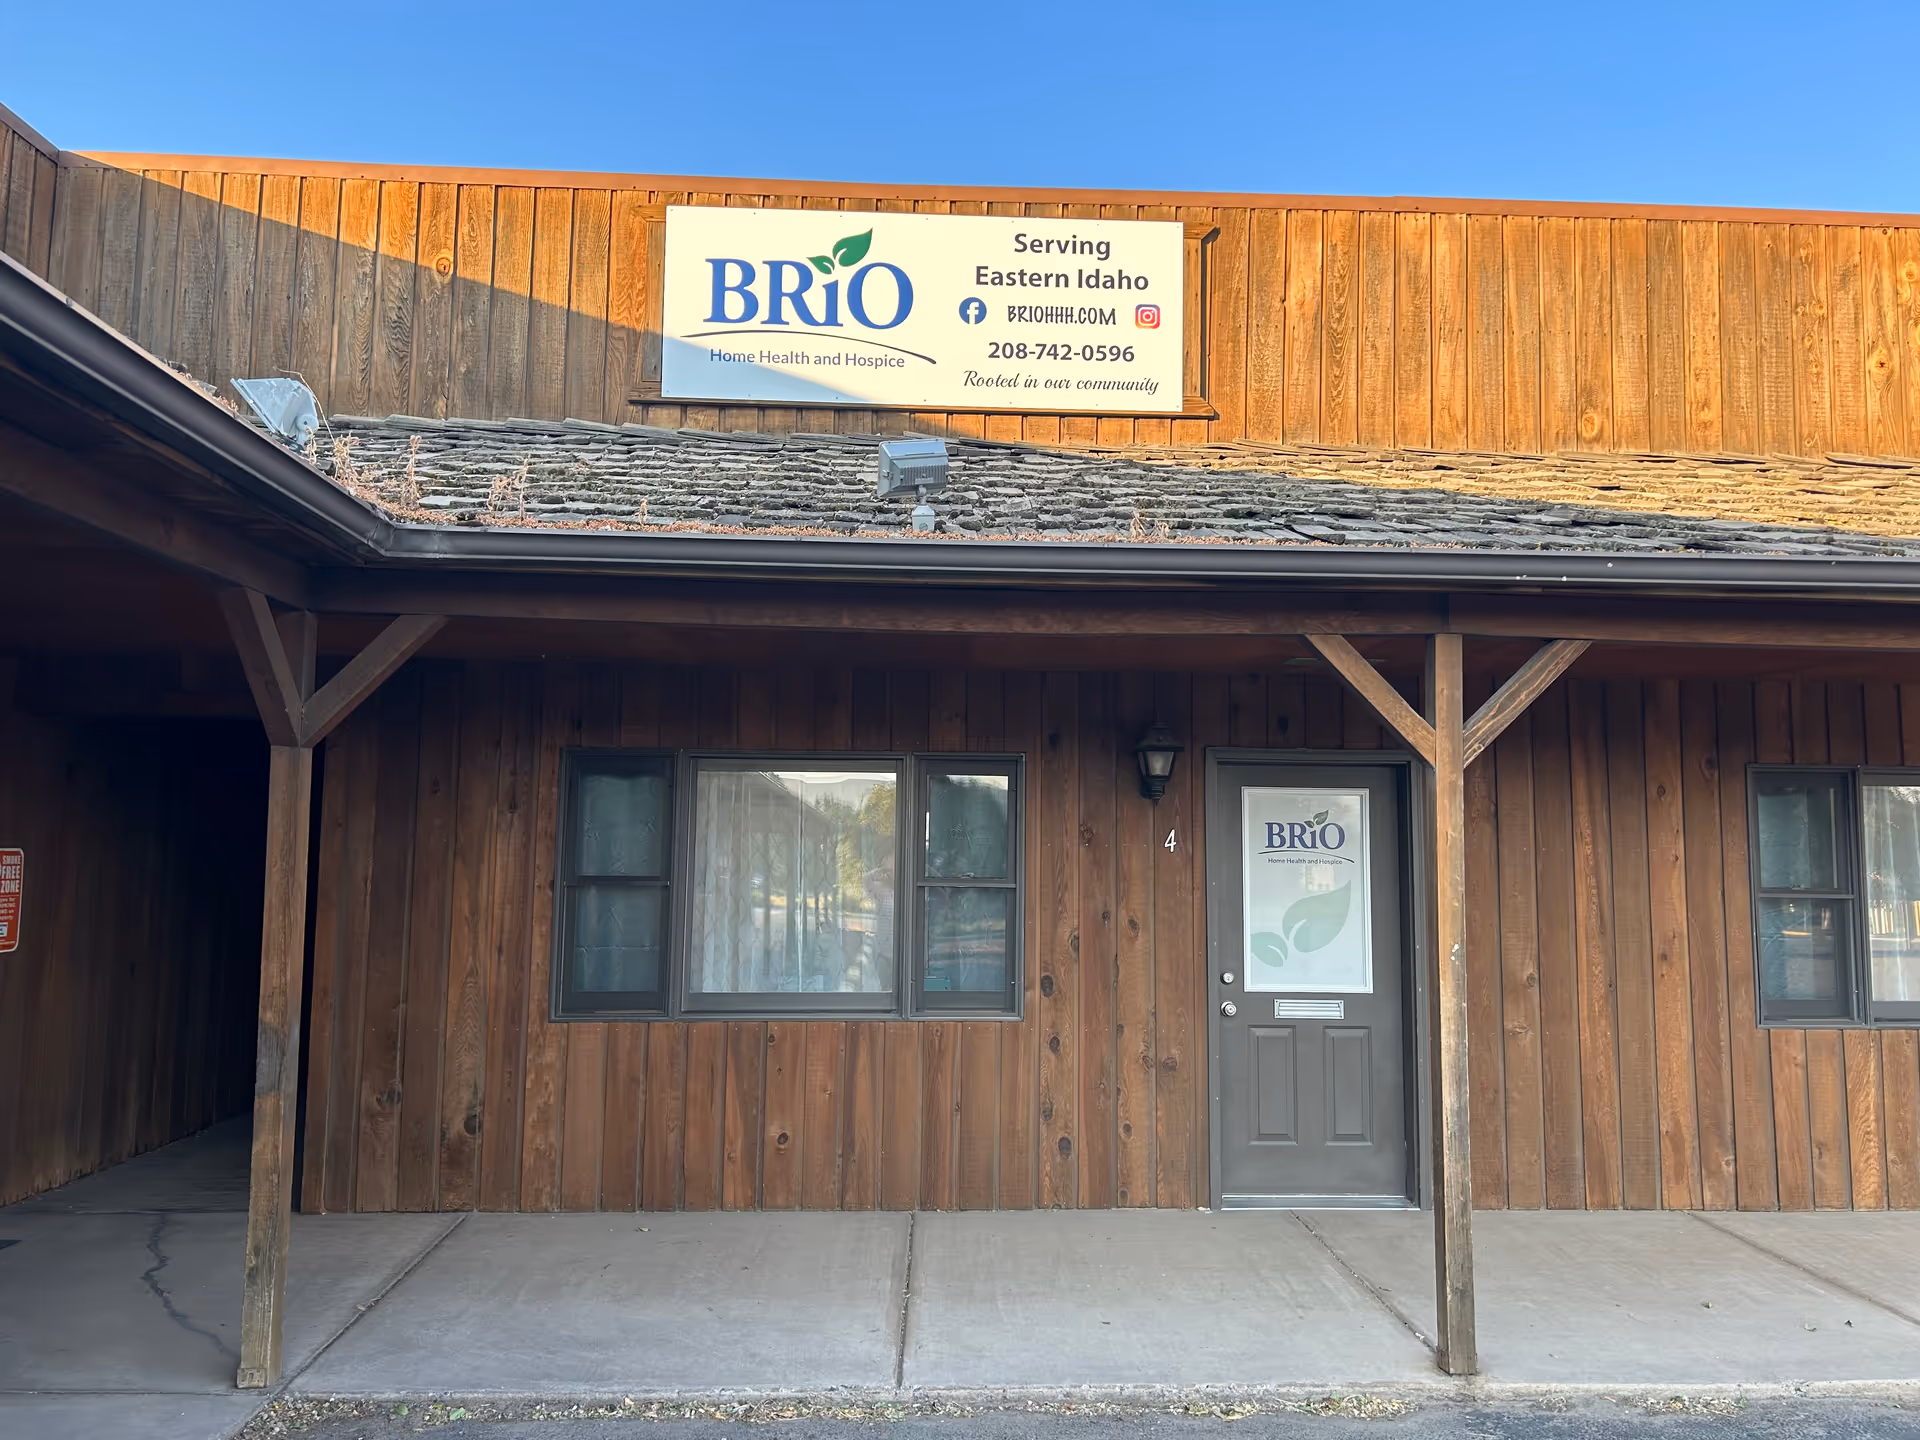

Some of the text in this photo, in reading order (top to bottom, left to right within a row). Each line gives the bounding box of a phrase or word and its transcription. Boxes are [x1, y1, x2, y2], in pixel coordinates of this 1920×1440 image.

[1013, 233, 1111, 261] Serving
[975, 266, 1149, 290] Eastern Idaho
[1007, 305, 1117, 325] BRIOHHH.COM
[710, 349, 905, 369] Home Health and Hospice
[988, 342, 1135, 362] 208-742-0596
[963, 370, 1160, 396] Rooted in our community
[1164, 829, 1177, 853] 4
[1, 866, 21, 879] FREE
[1, 880, 20, 893] ZONE
